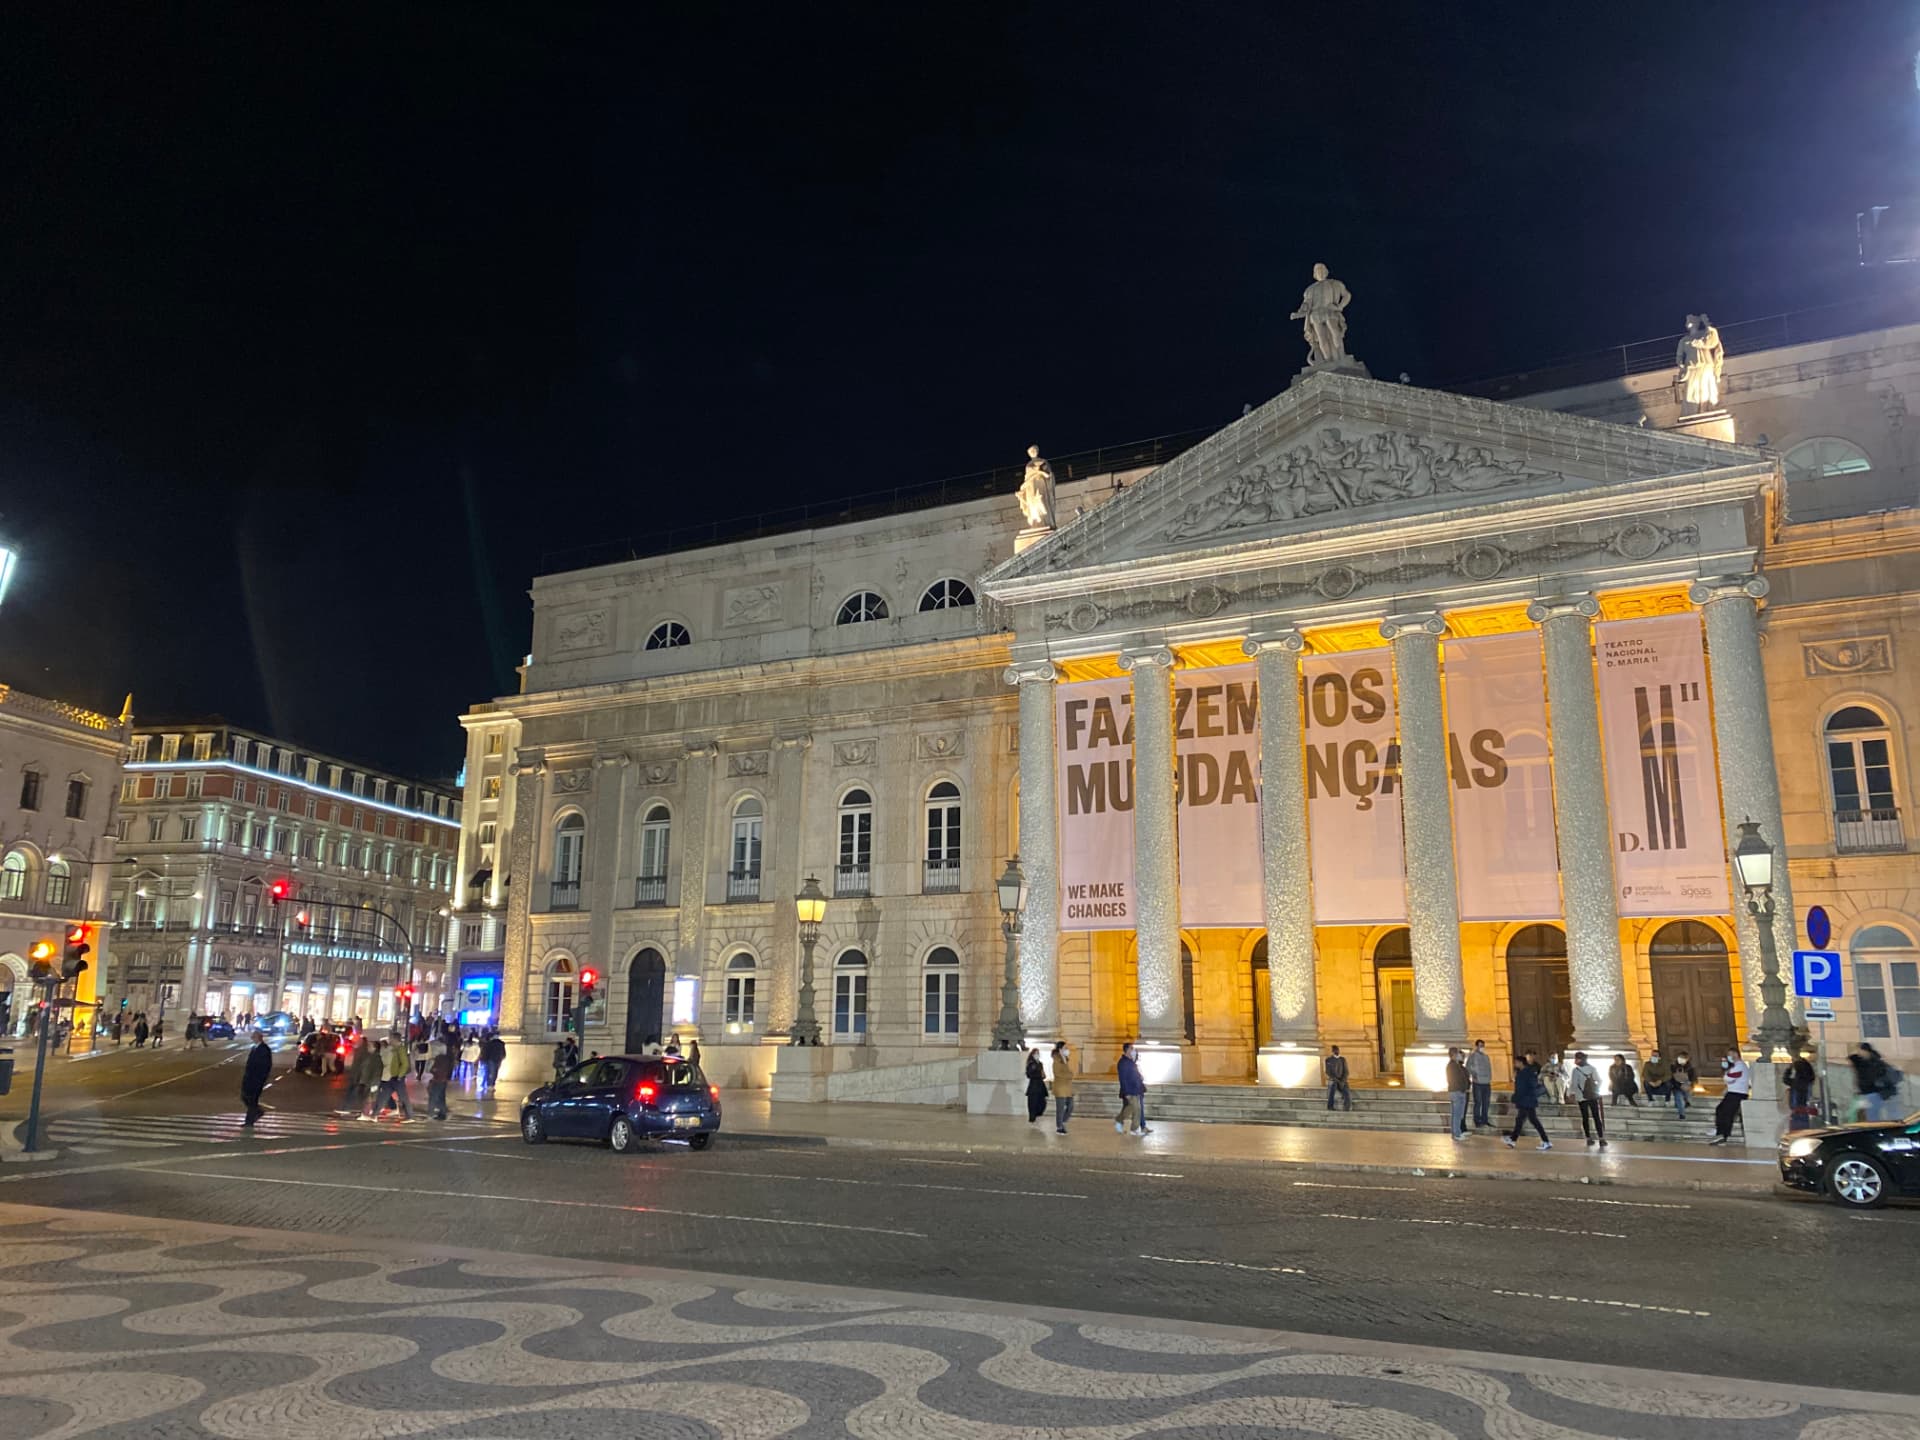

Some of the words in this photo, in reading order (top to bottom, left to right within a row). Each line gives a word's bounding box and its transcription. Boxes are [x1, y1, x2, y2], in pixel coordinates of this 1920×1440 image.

[1605, 640, 1643, 649] TEATRO
[1606, 647, 1656, 658] NACIONAL
[1618, 657, 1650, 666] MARIA
[1068, 884, 1087, 899] WE
[1089, 882, 1125, 898] MAKE
[1067, 902, 1127, 918] CHANGES
[290, 943, 322, 956] HOTEL
[1803, 955, 1832, 993] P
